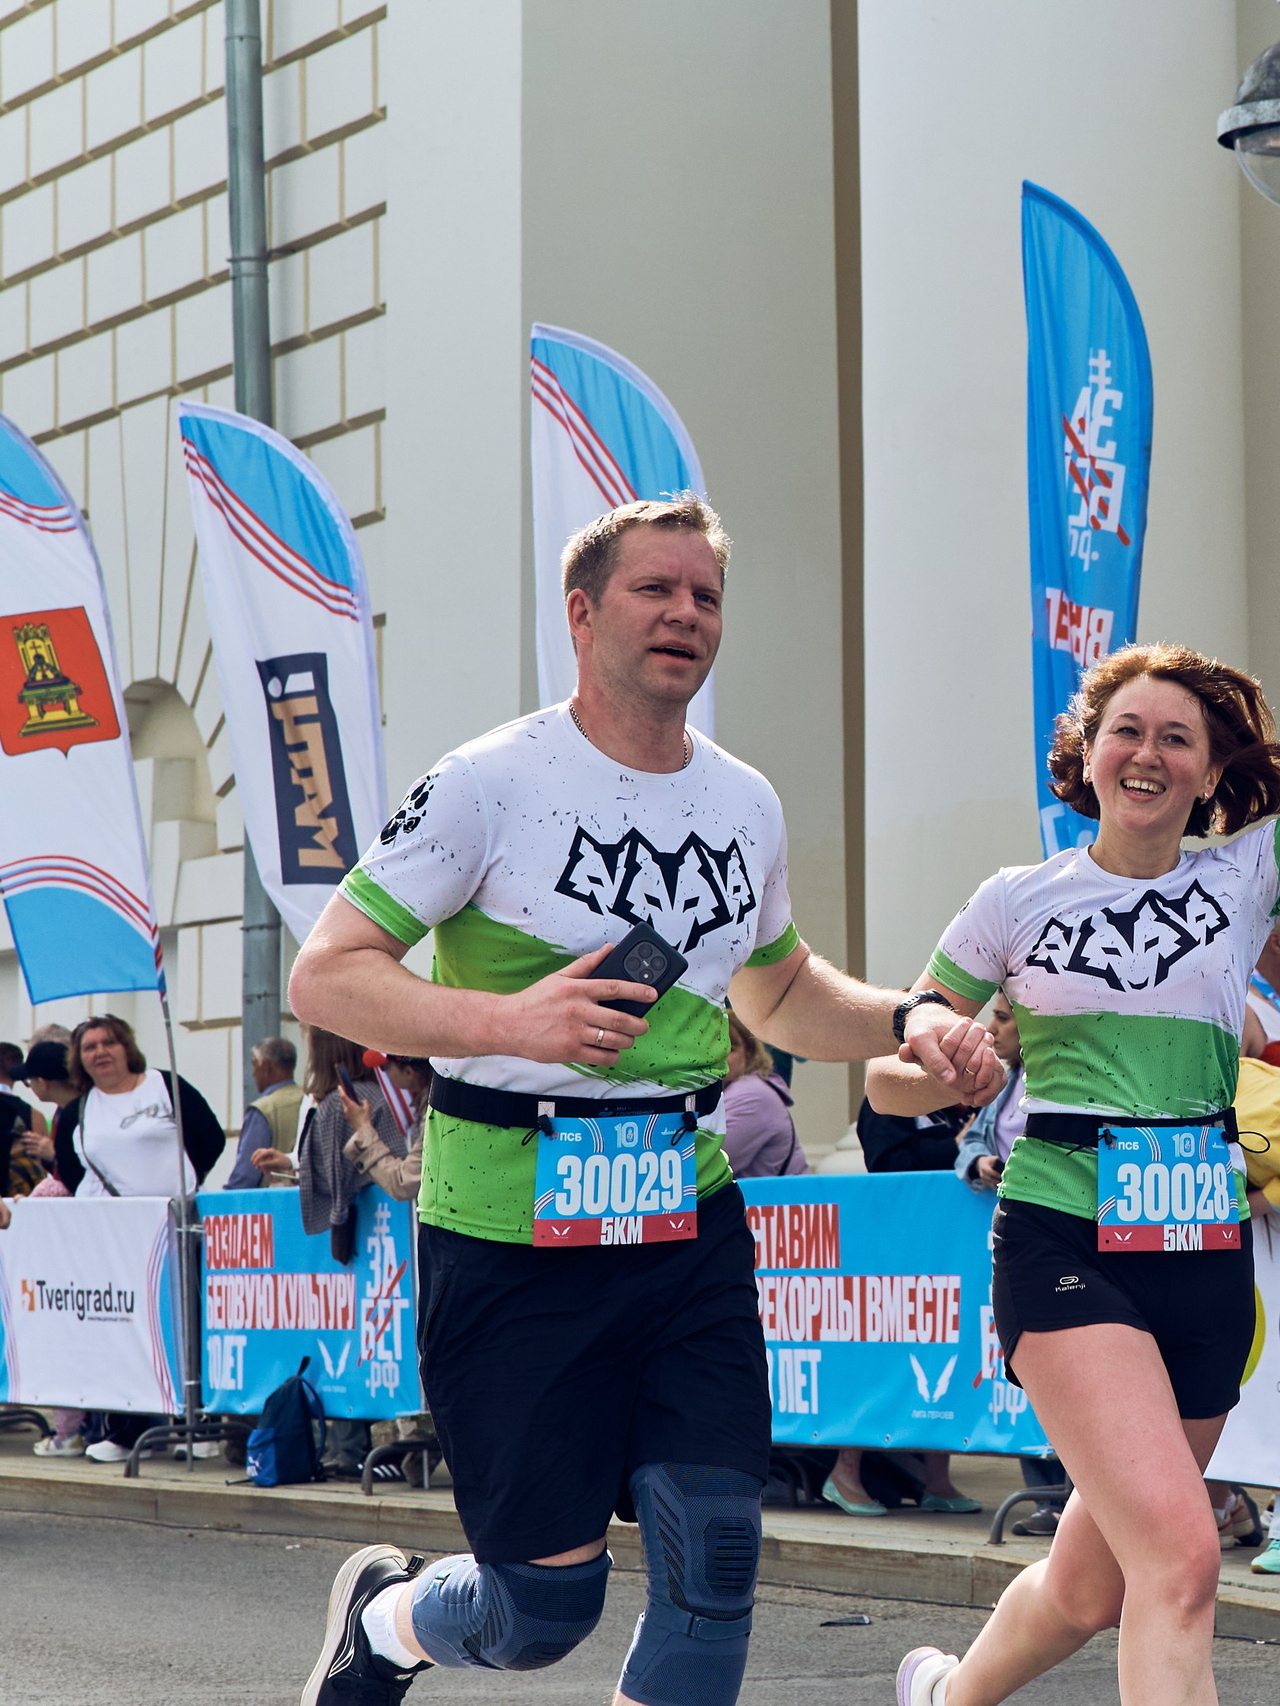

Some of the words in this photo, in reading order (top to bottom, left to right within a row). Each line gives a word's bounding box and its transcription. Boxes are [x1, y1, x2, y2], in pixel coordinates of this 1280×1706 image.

[559, 1132, 583, 1142] ПСБ
[614, 1121, 639, 1148] 10
[1117, 1141, 1140, 1151] ПСБ
[1172, 1132, 1196, 1158] 10
[555, 1149, 683, 1216] 30029
[1116, 1162, 1230, 1222] 30028
[366, 1236, 402, 1299] ЗА
[1055, 1282, 1086, 1293] Kalenji
[36, 1280, 135, 1321] Tverigrad.ru
[277, 1273, 356, 1330] КУЛЬТУРУ
[866, 1275, 961, 1343] ВМЕСТЕ
[778, 1348, 822, 1415] ЛЕТ
